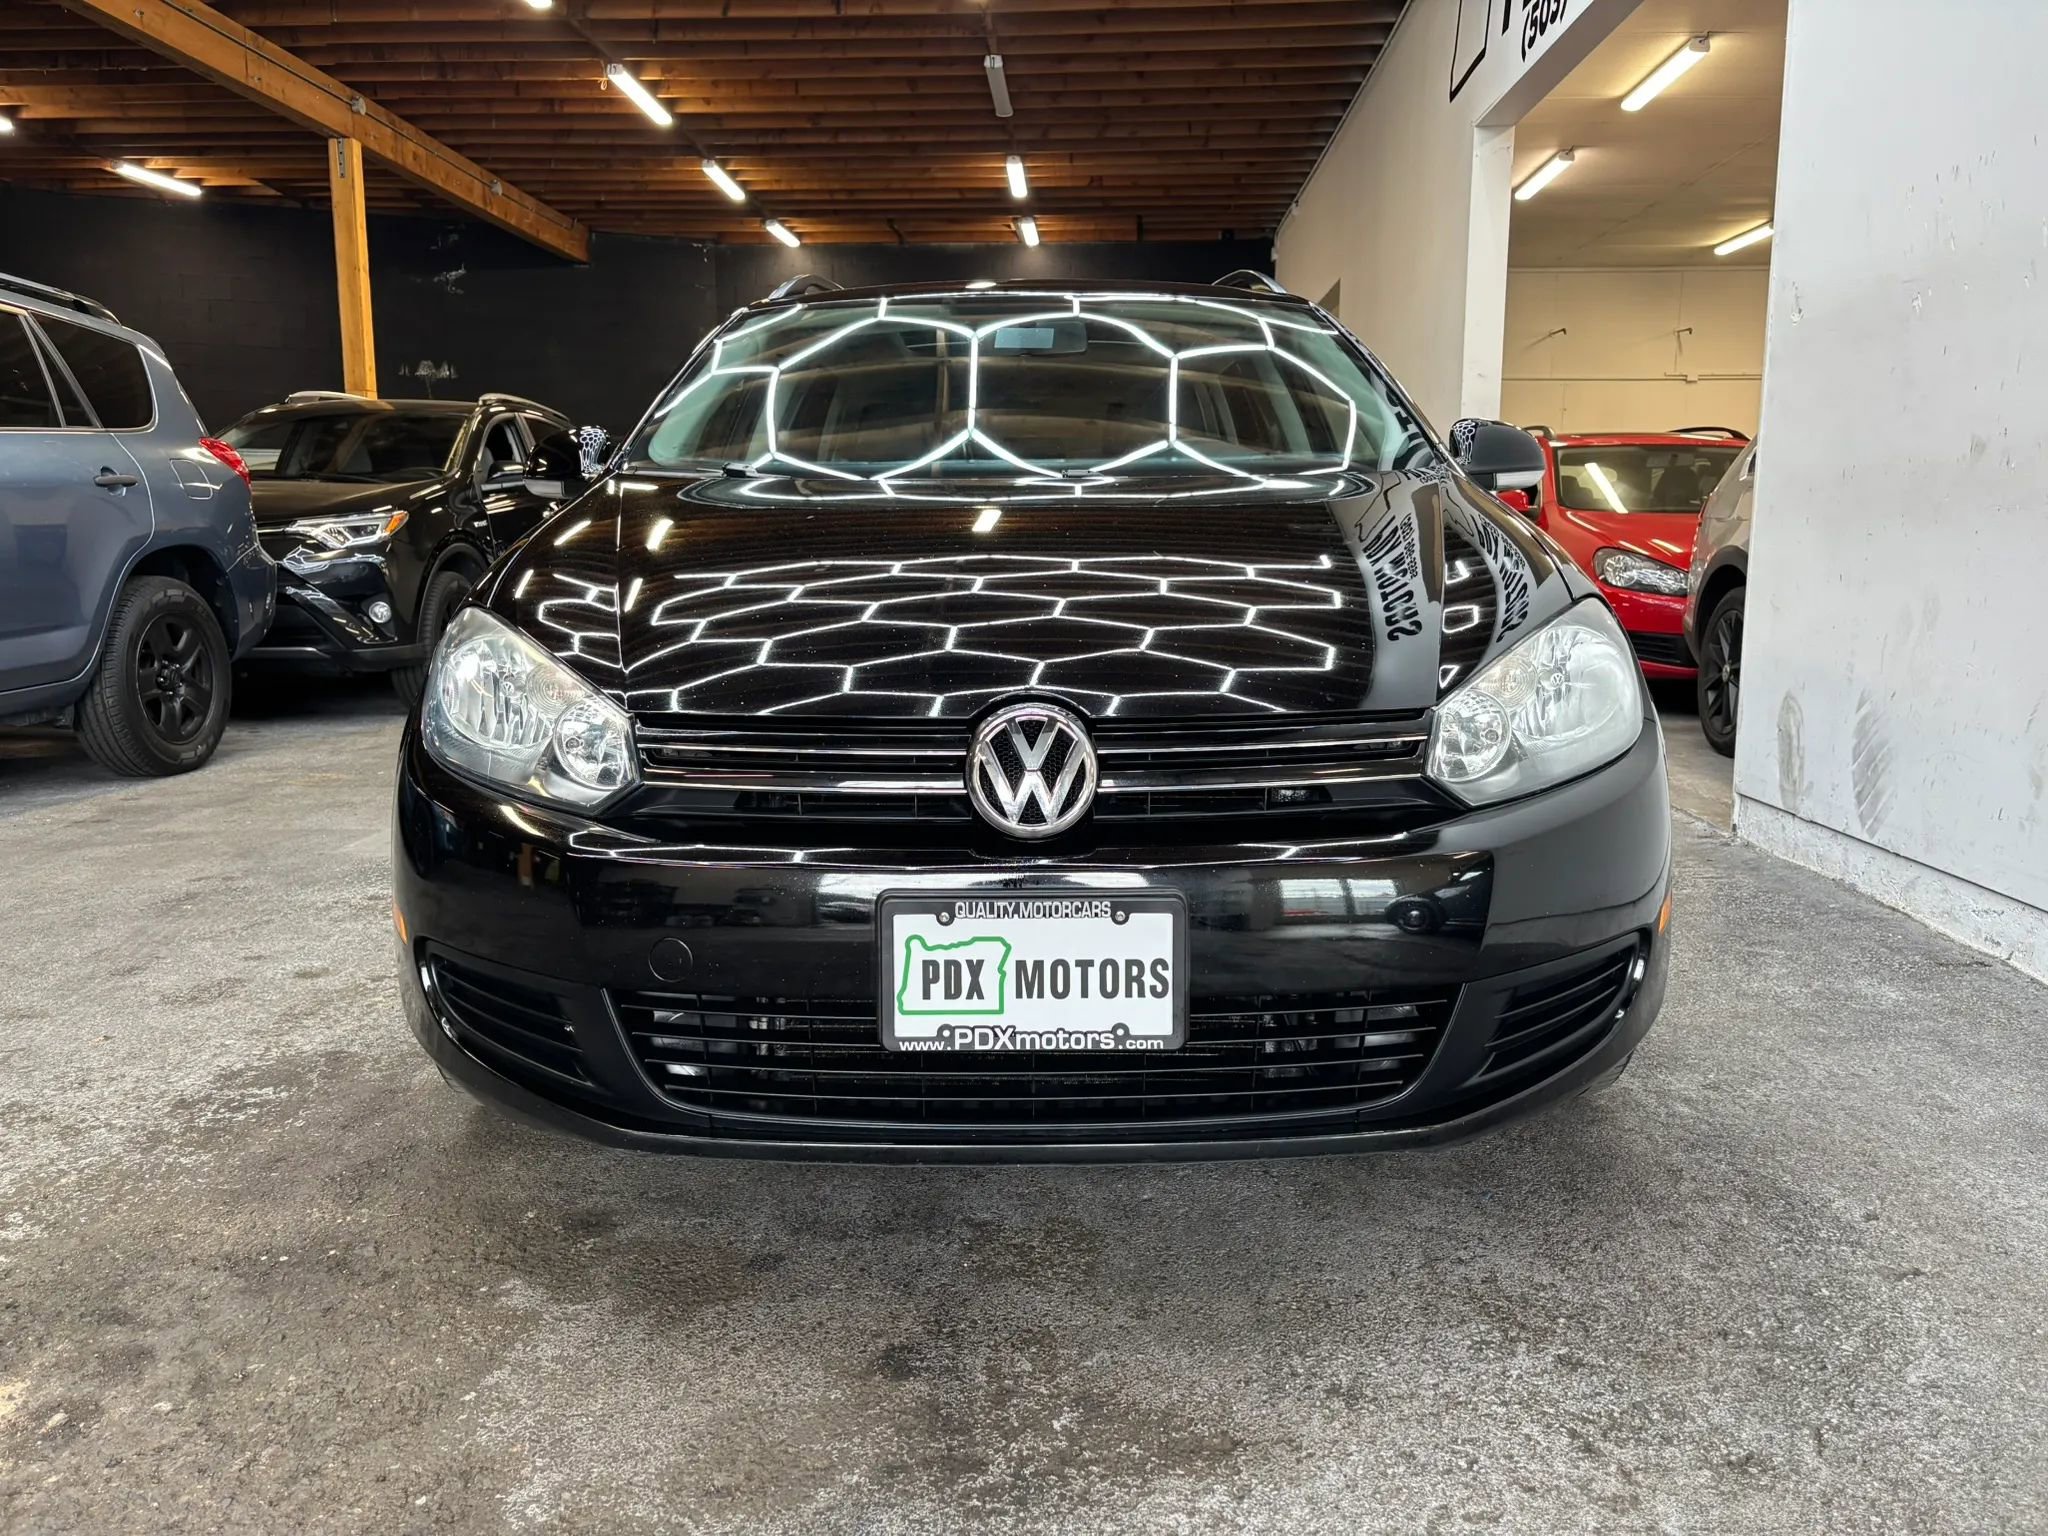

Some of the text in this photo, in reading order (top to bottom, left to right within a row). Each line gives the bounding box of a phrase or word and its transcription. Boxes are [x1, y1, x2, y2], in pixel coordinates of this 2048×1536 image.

[954, 900, 1112, 919] QUALITY MOTORCARS
[921, 958, 1170, 1001] PDX MOTORS
